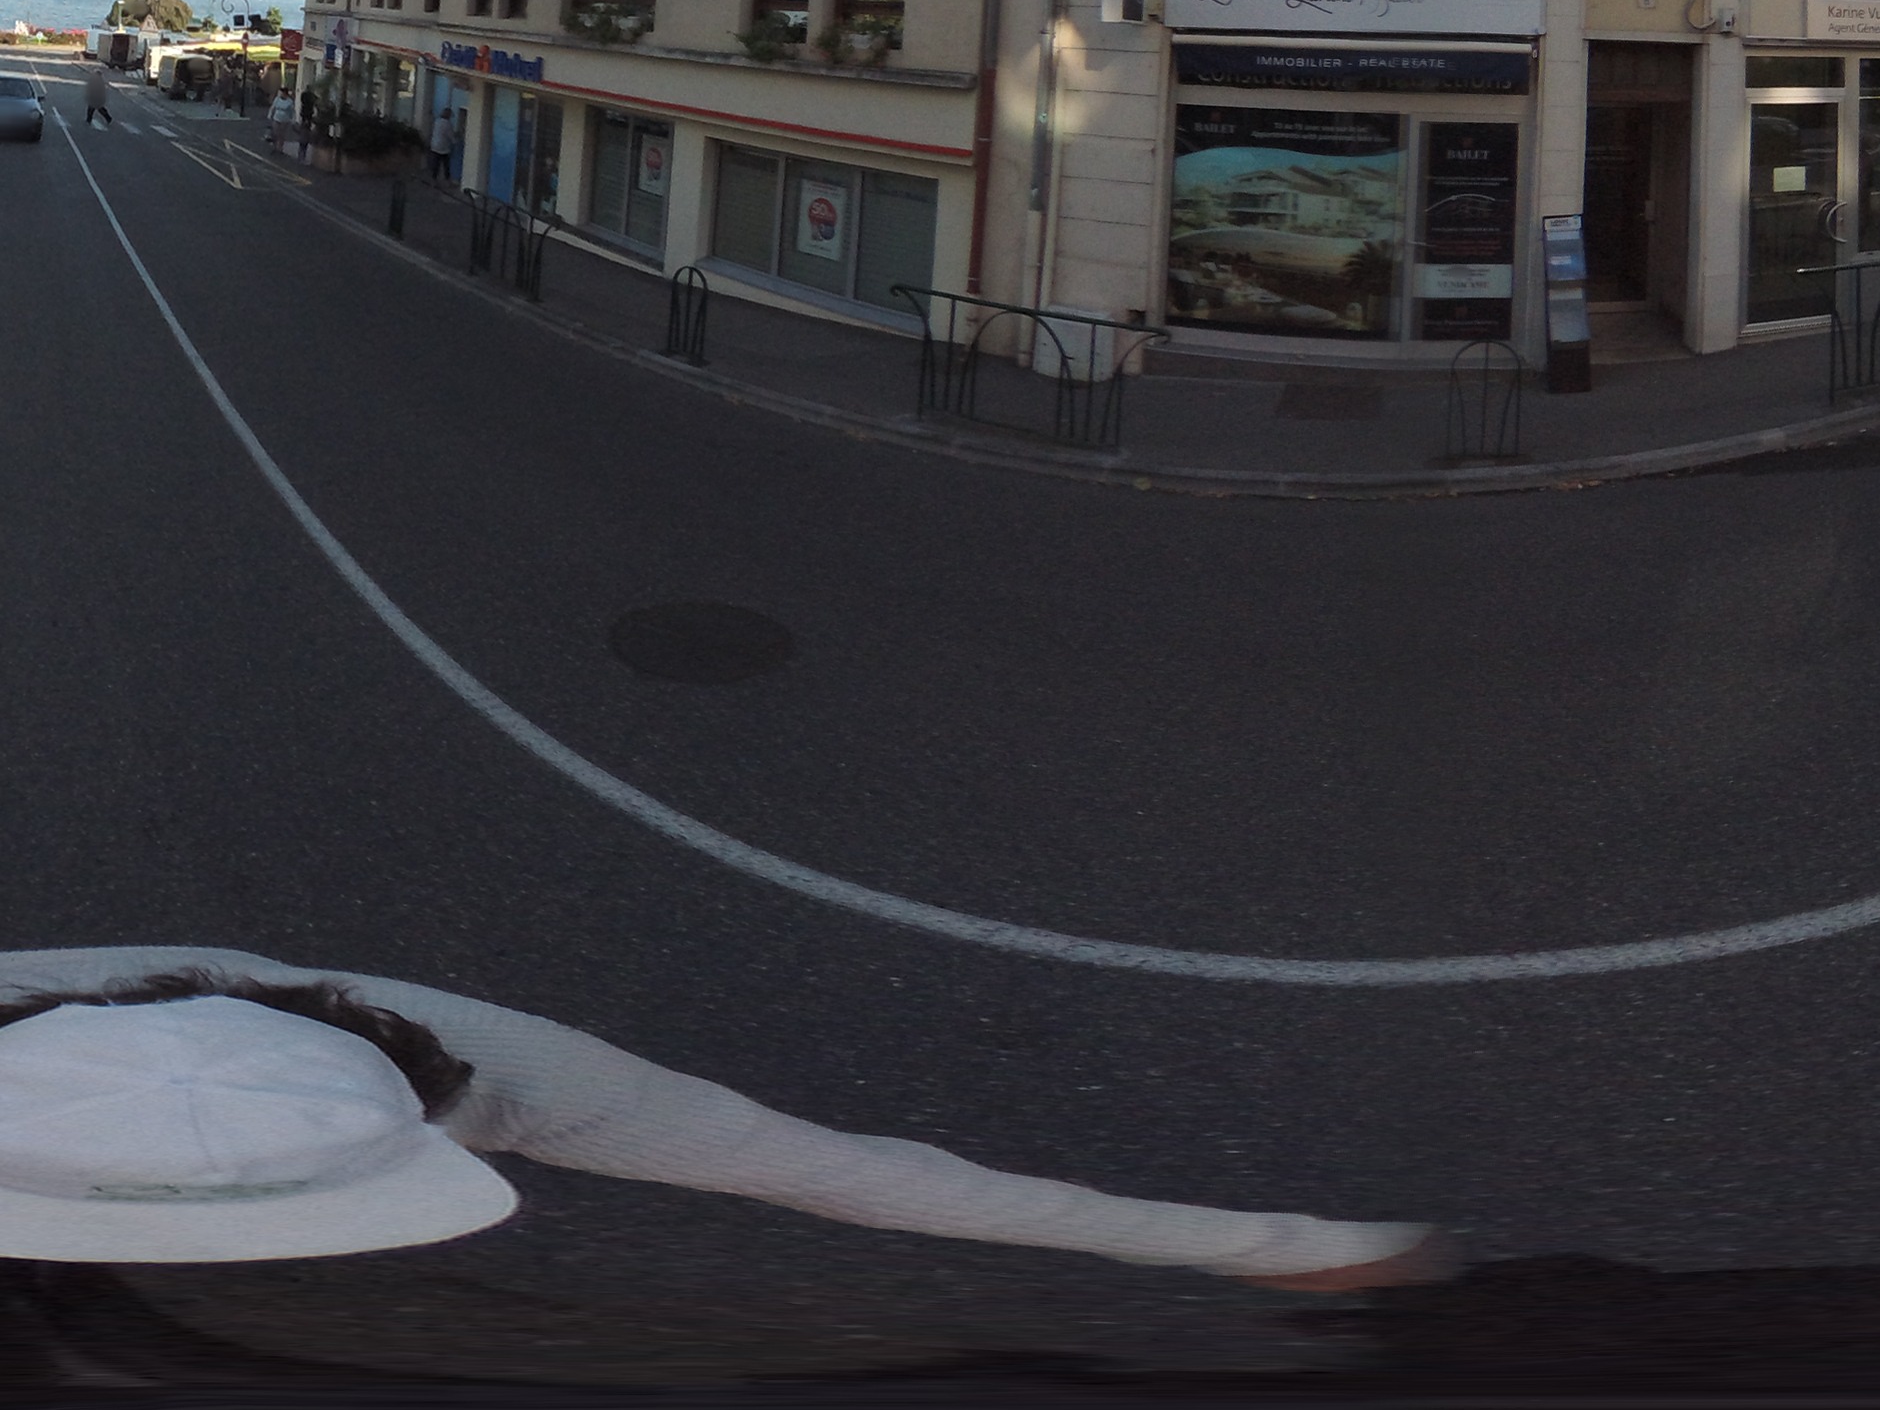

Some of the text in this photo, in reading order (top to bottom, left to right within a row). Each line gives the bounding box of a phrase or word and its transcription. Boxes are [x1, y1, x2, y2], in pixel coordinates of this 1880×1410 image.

[1828, 6, 1865, 19] Karine
[1828, 23, 1855, 35] Agent
[1256, 55, 1342, 68] IMMOBILIER
[1359, 58, 1396, 68] REAL
